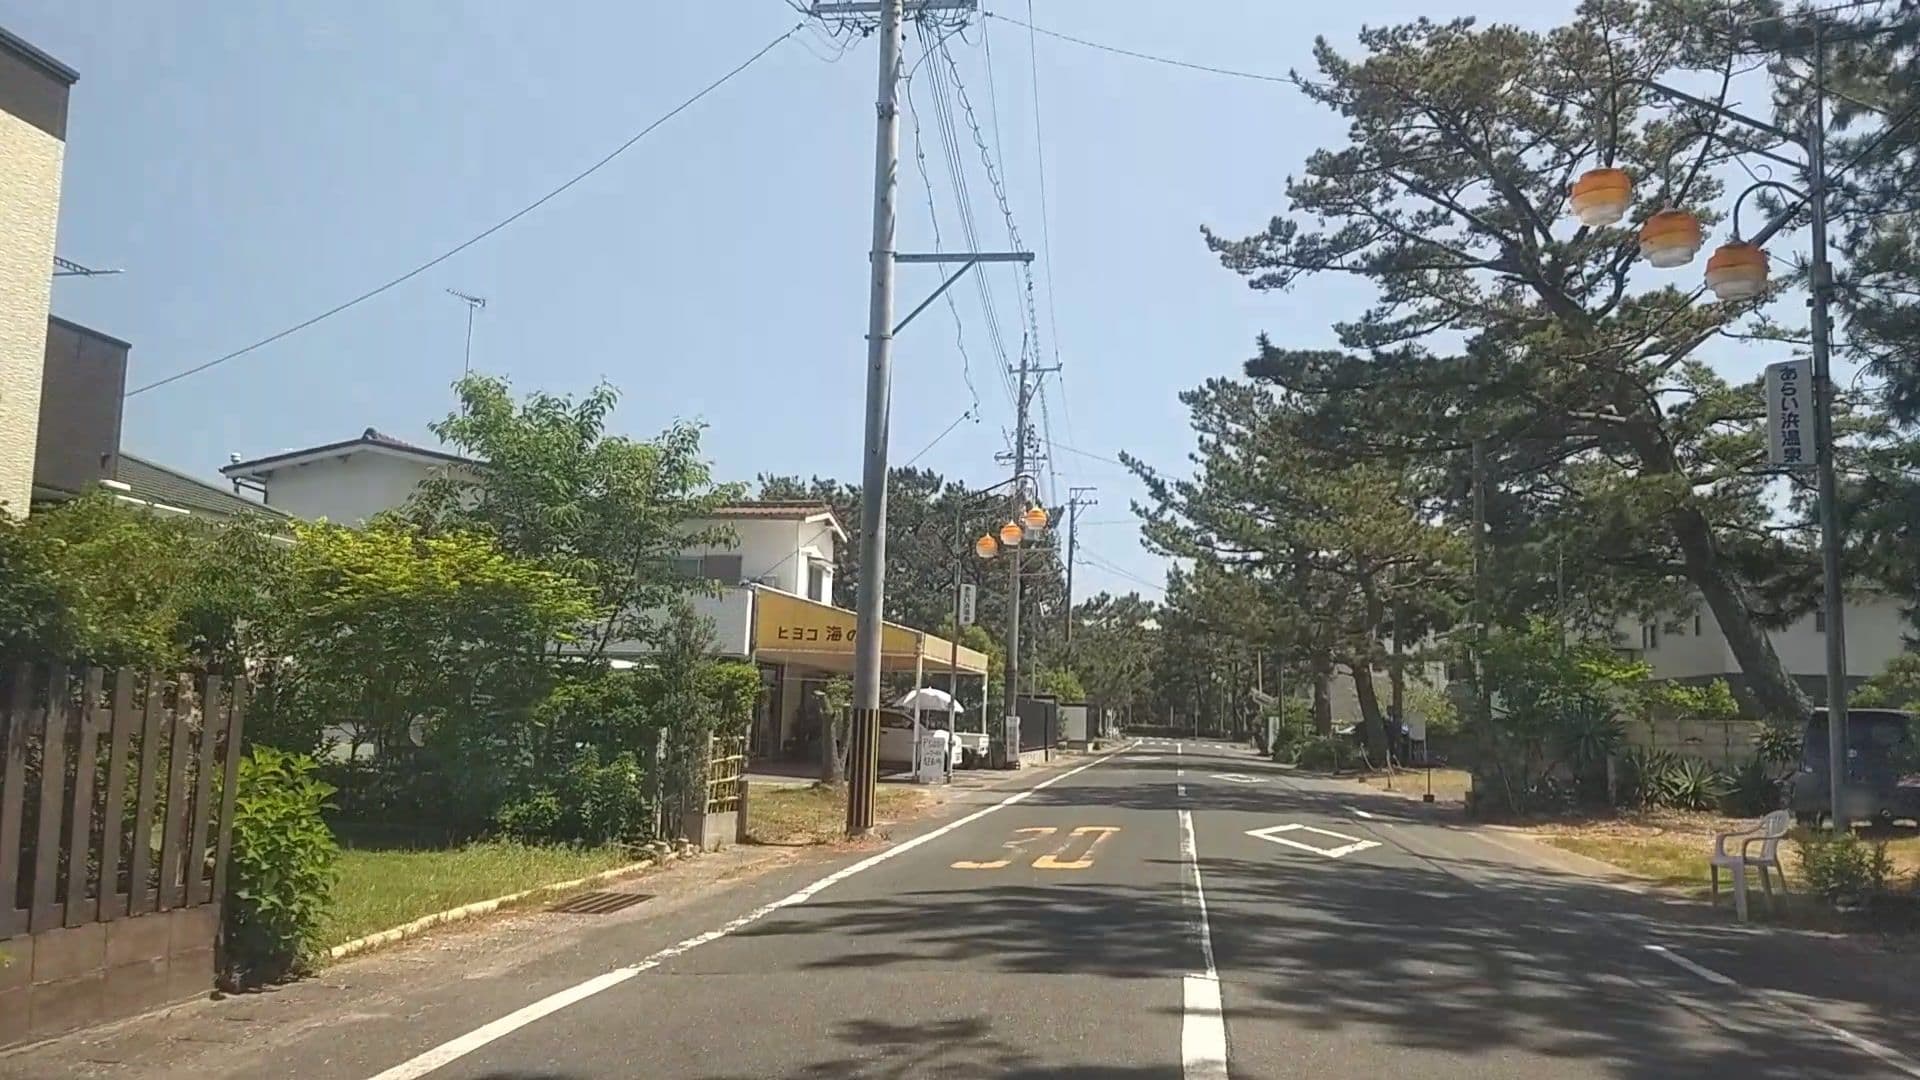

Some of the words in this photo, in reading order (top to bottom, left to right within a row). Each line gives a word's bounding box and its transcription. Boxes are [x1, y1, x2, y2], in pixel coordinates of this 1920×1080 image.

[1780, 365, 1802, 463] あらい浜温泉
[778, 626, 818, 641] ヒヨコ
